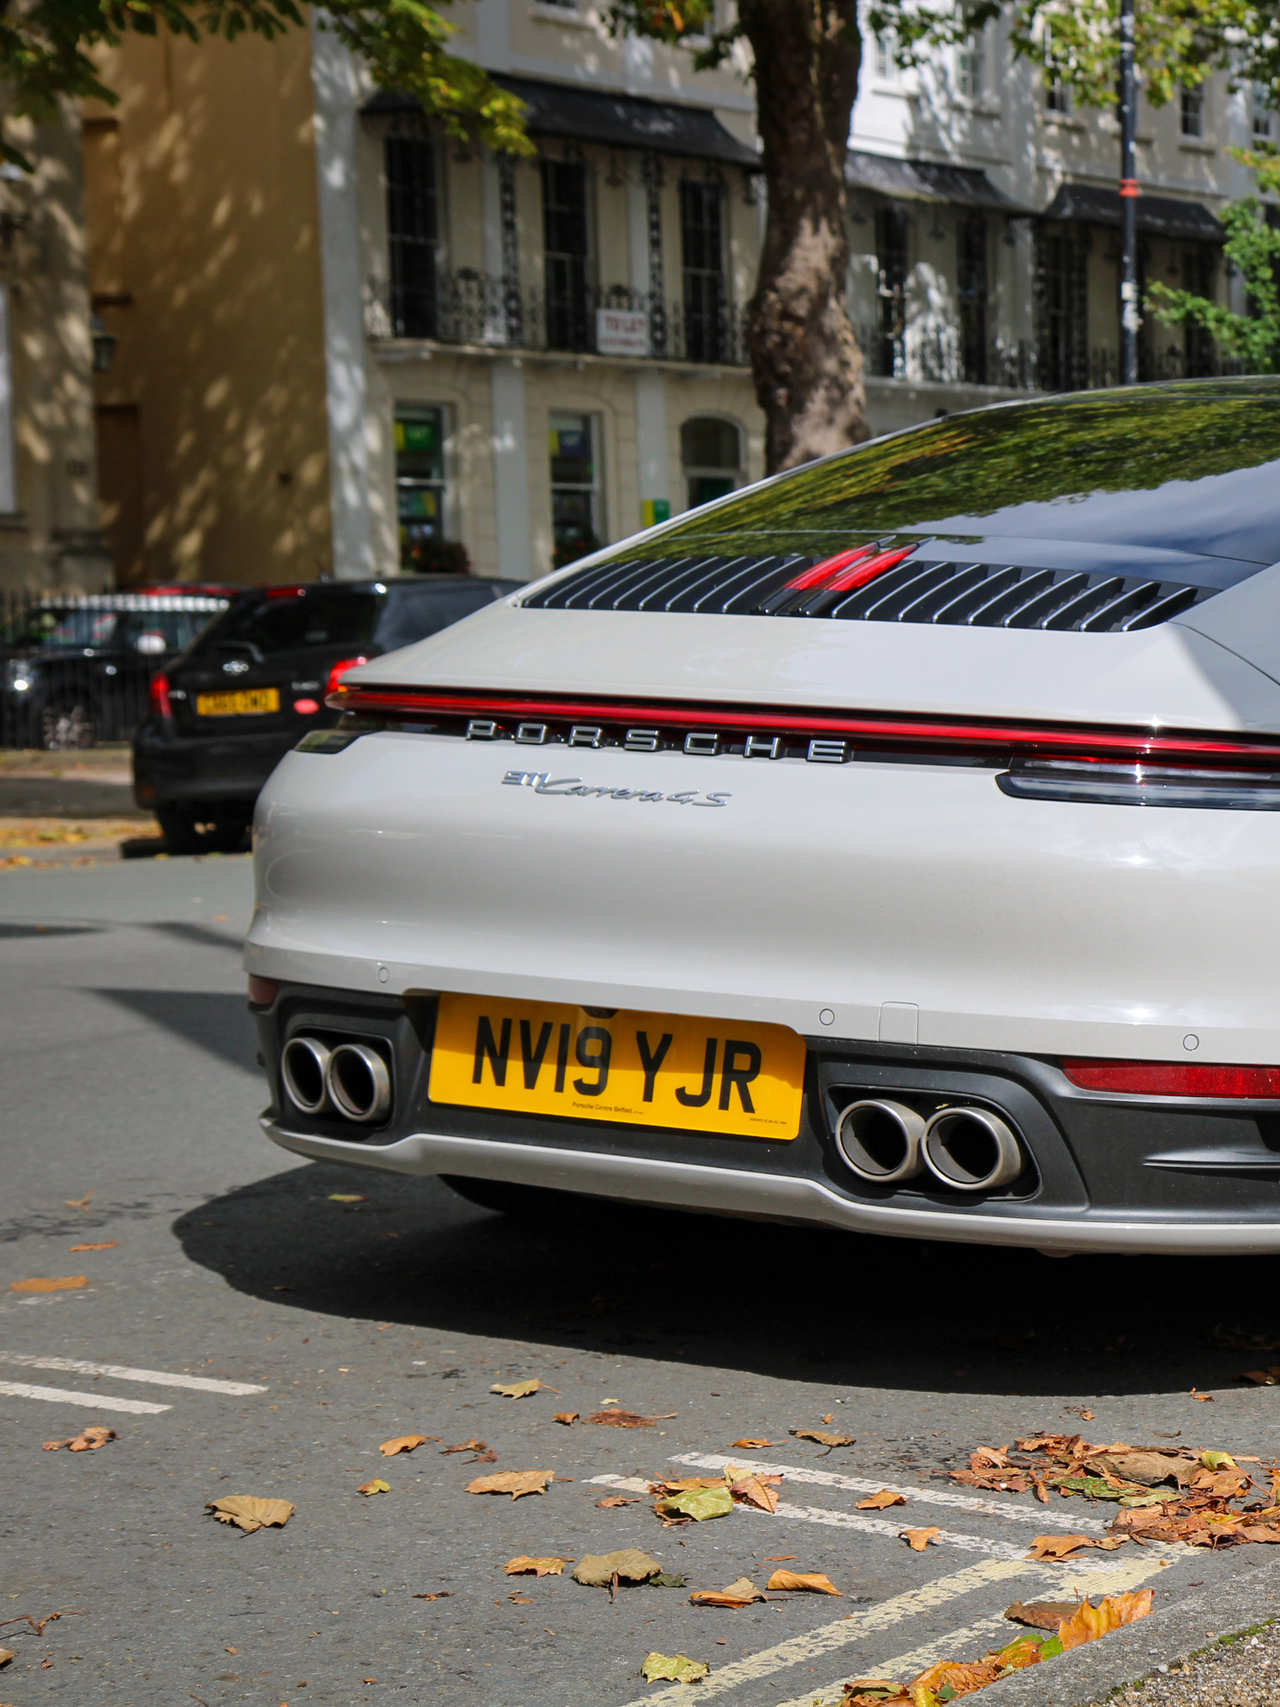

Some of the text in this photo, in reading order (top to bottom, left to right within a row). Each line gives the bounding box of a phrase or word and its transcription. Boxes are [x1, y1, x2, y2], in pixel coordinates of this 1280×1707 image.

[604, 315, 646, 334] TO LET
[466, 719, 849, 764] PORSCHE
[501, 770, 551, 787] 911
[534, 778, 664, 803] Carrera
[472, 1015, 762, 1114] NV19 YJR
[572, 1101, 594, 1110] Porsche
[595, 1103, 612, 1112] Centre
[613, 1105, 633, 1114] Belfast
